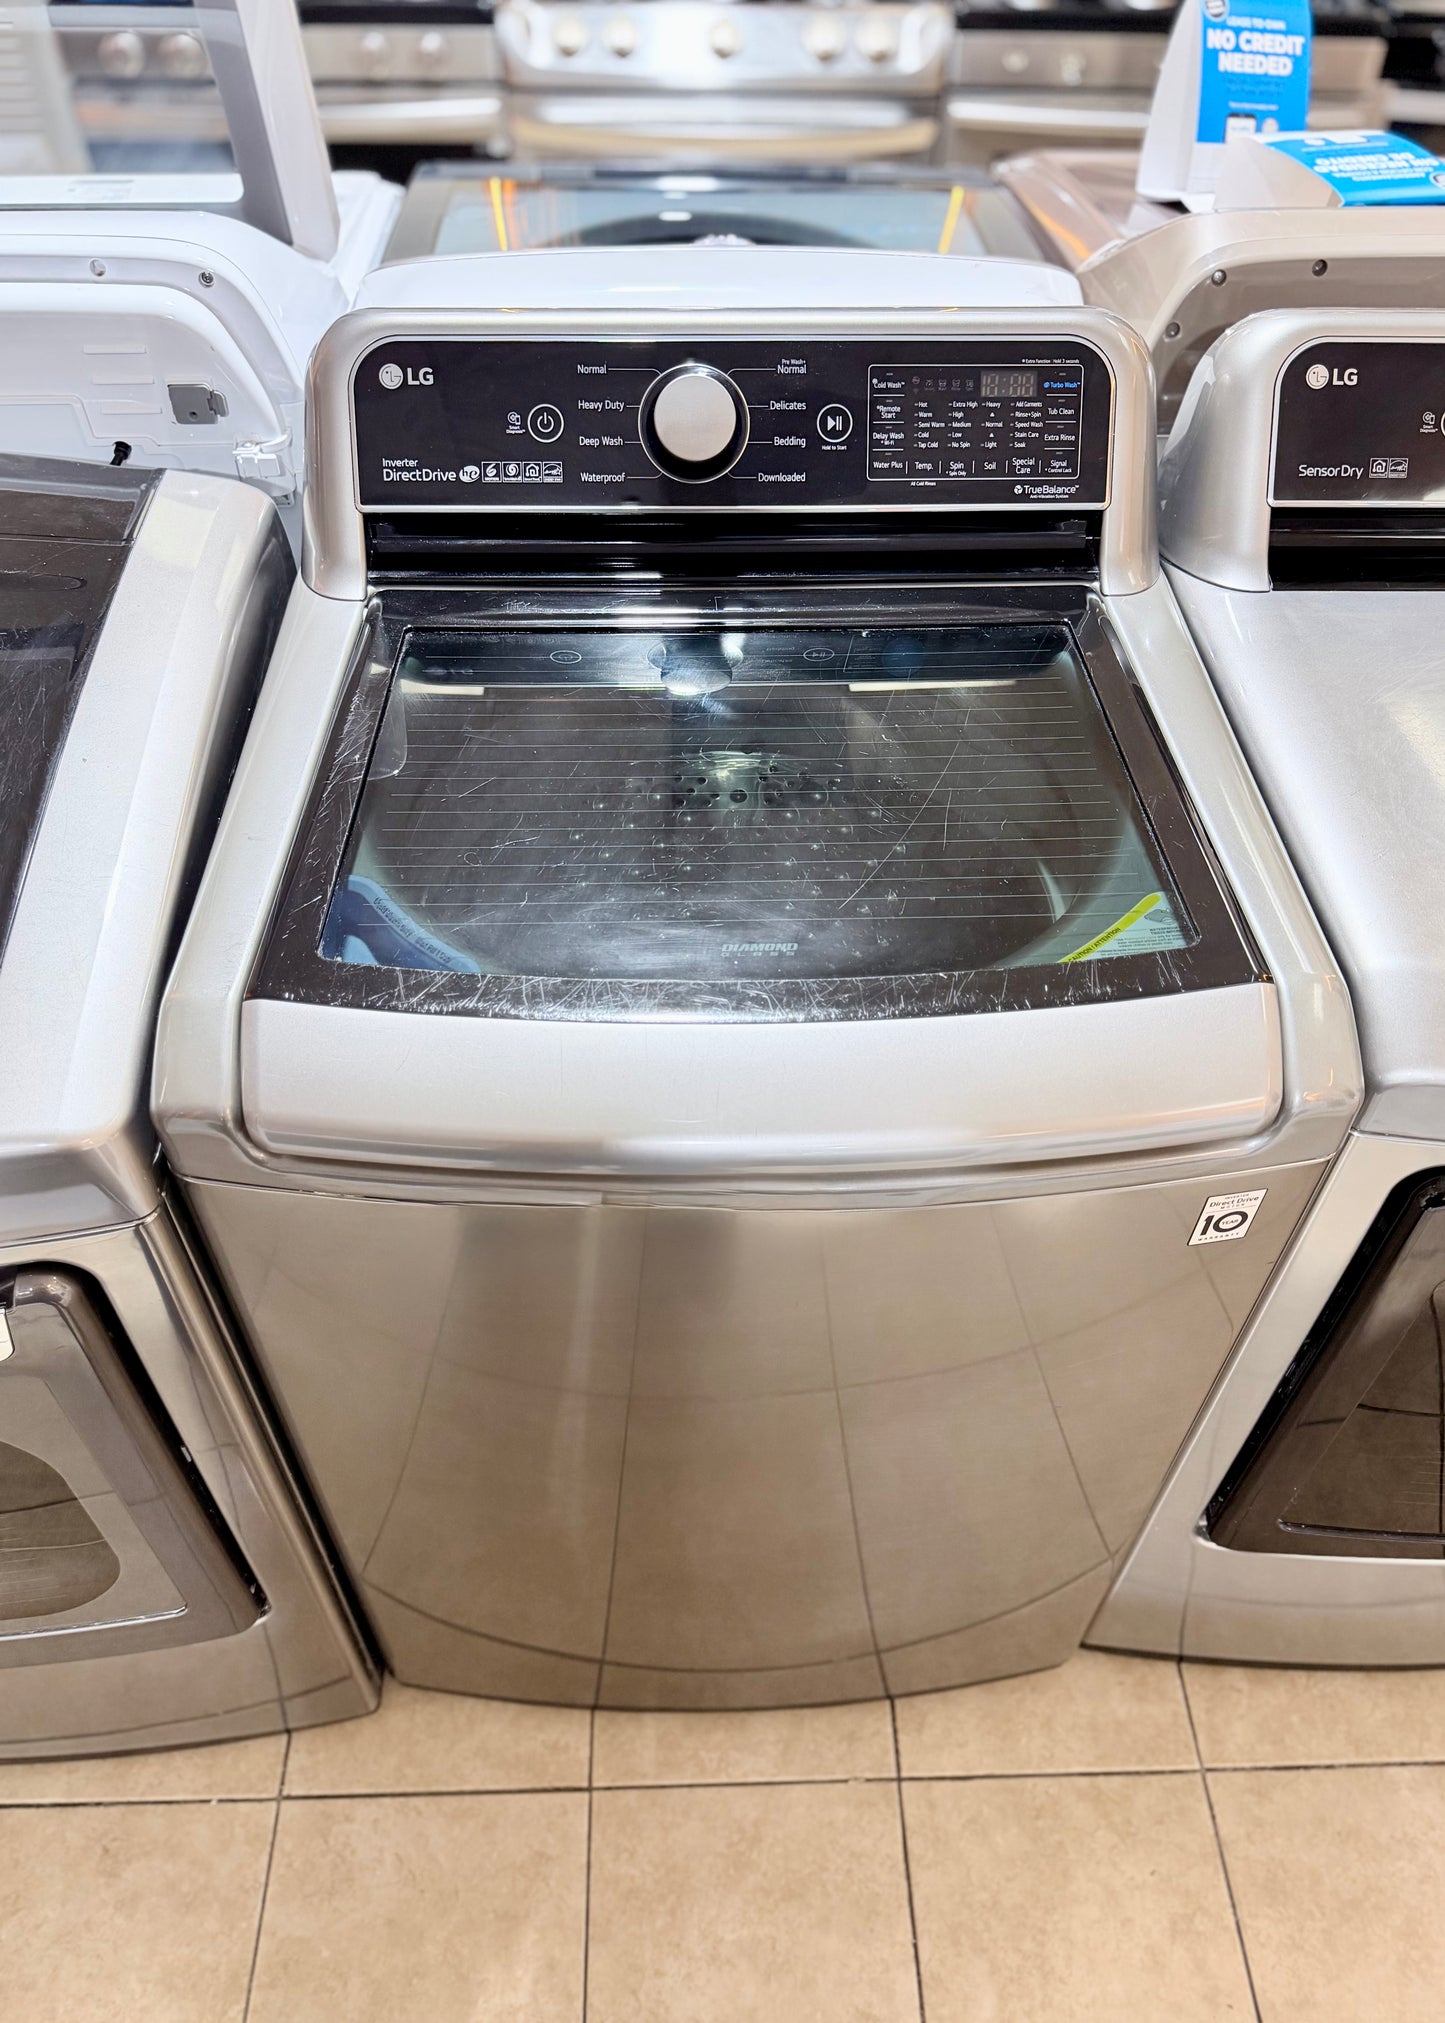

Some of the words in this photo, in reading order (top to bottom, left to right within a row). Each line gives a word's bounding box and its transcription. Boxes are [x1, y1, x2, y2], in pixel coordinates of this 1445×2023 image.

[1206, 28, 1237, 51] NO
[1238, 30, 1305, 56] CREDIT
[1218, 51, 1293, 76] NEEDED
[577, 364, 607, 374] Normal
[777, 364, 807, 374] Normal
[407, 367, 434, 386] LG
[1332, 368, 1358, 386] LG
[578, 400, 604, 411] Heavy
[605, 400, 624, 411] Duty
[770, 401, 807, 411] Delicates
[872, 432, 888, 440] Delay
[579, 436, 601, 447] Deep
[602, 436, 624, 446] Wash
[774, 436, 806, 448] Bedding
[382, 458, 418, 468] Inverter
[915, 462, 934, 471] Temp.
[950, 462, 964, 470] Spin
[984, 462, 997, 470] Soil
[1012, 458, 1035, 466] Special
[1050, 460, 1067, 468] Signal
[1016, 466, 1031, 474] Care
[580, 472, 626, 483] Waterproof
[758, 472, 806, 482] Downloaded
[1094, 927, 1121, 950] ATTENTION
[722, 943, 798, 952] DIAMOND
[1210, 1200, 1235, 1208] Direct
[1236, 1196, 1260, 1204] Drive
[1200, 1211, 1248, 1236] 10
[1198, 1232, 1240, 1241] WARRANTY
